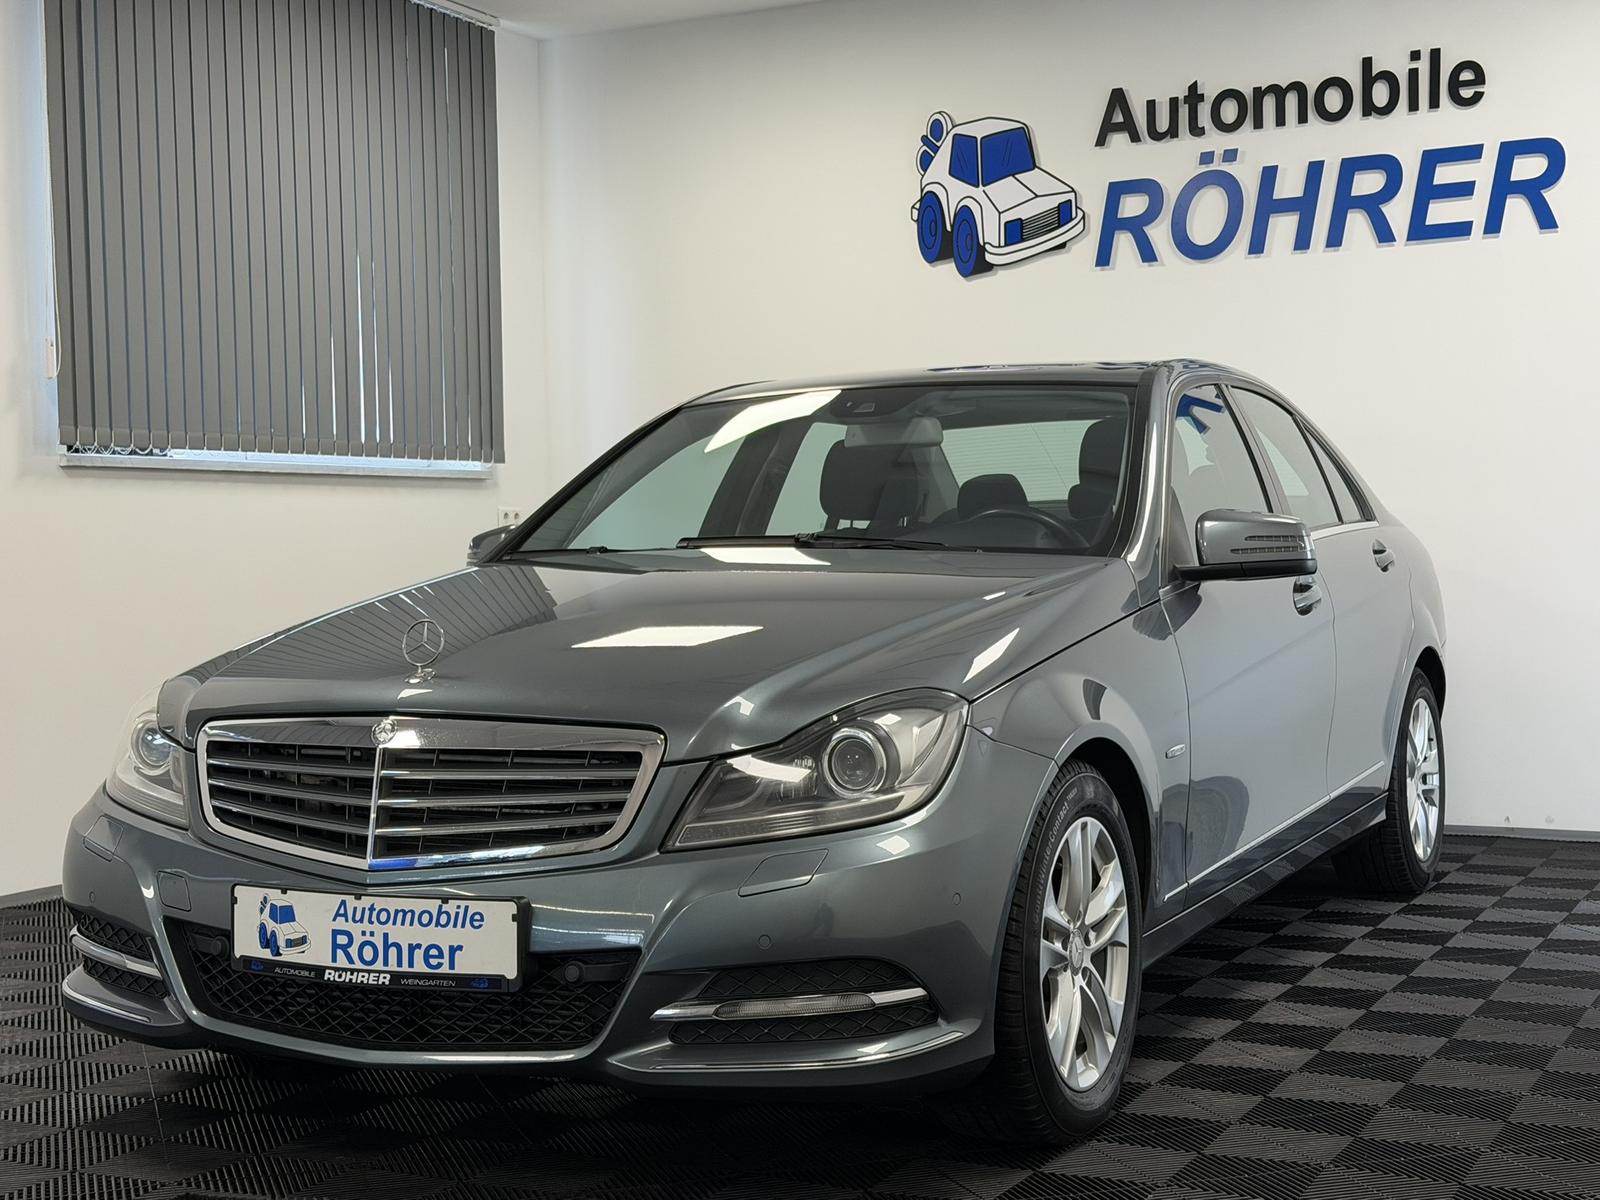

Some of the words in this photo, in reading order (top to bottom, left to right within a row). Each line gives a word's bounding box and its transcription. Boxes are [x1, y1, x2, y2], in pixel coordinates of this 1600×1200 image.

[1095, 48, 1486, 147] Automobile
[1096, 138, 1566, 267] RÖHRER
[332, 899, 485, 930] Automobile
[330, 928, 464, 972] Röhrer
[274, 967, 316, 978] AUTOMOBILE
[323, 969, 391, 986] RÖHRER
[400, 978, 456, 987] WEINGARTEN
